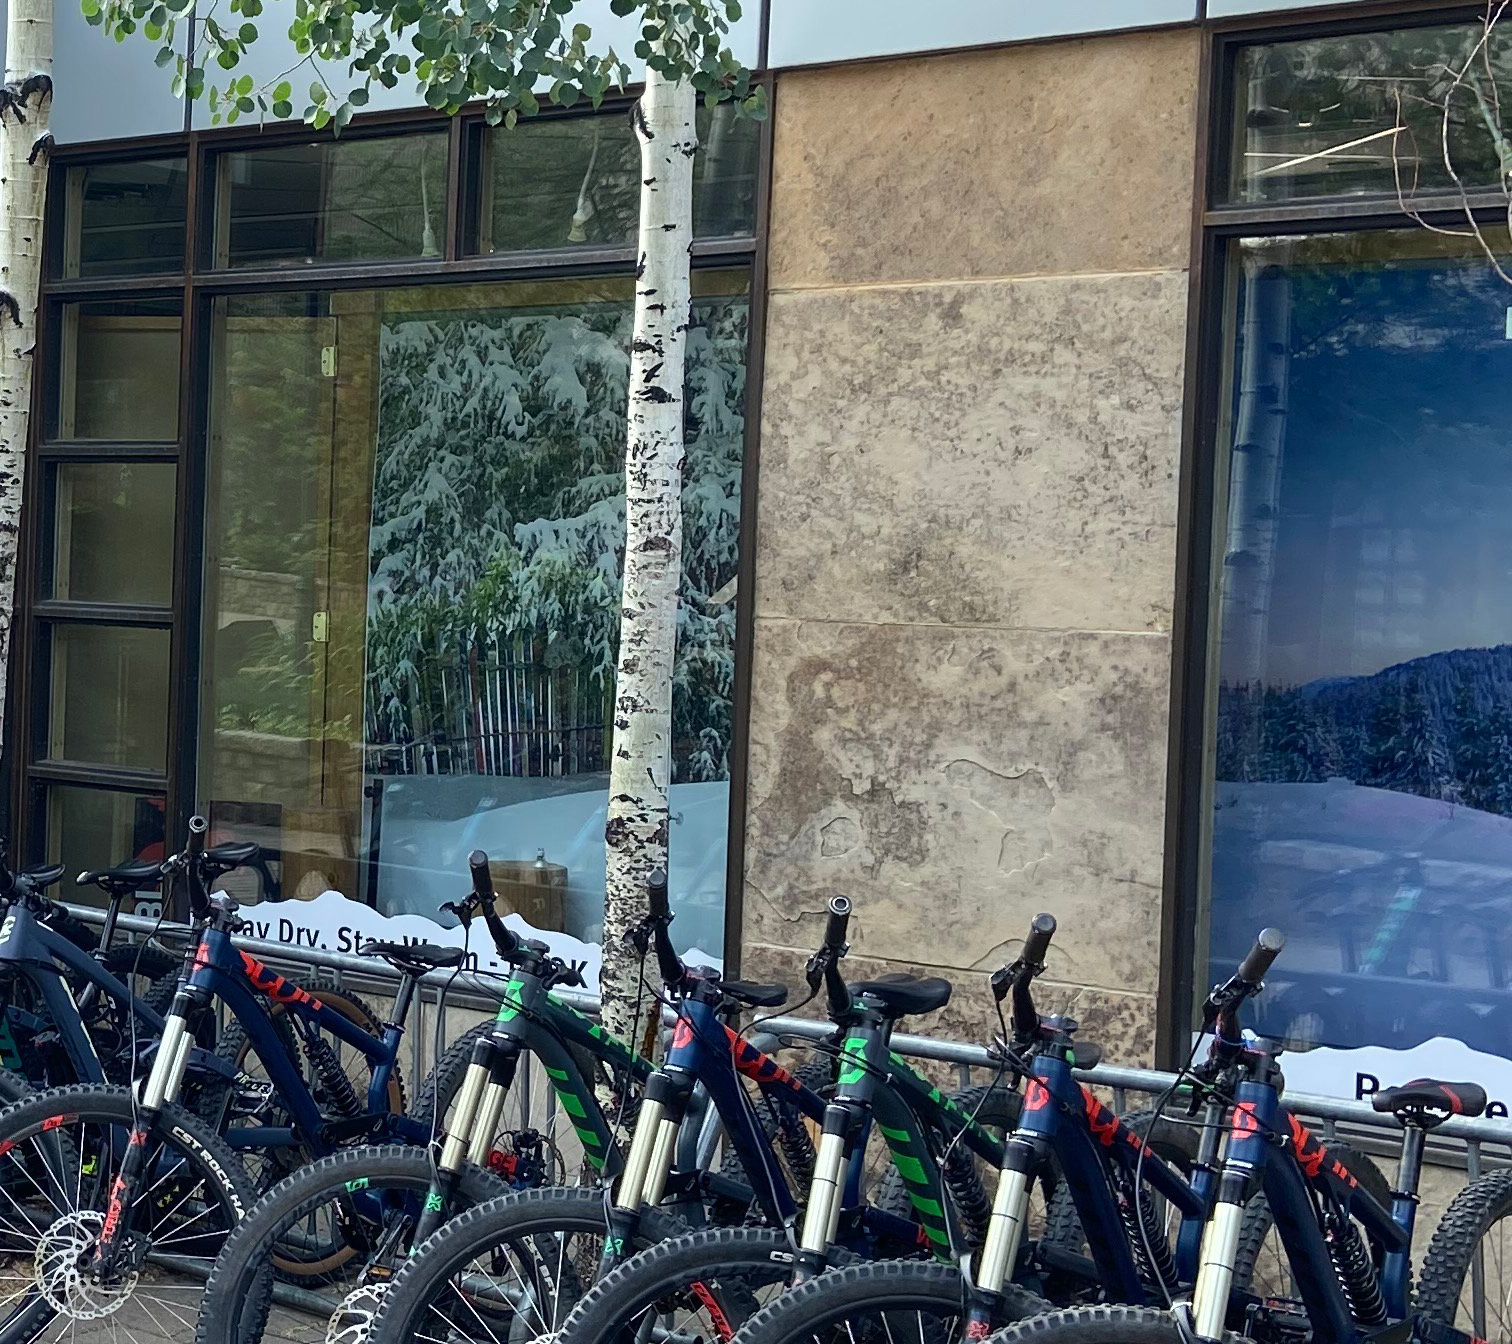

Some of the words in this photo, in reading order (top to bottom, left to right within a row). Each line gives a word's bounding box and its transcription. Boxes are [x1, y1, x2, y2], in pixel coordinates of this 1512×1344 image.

[172, 1126, 203, 1150] CST
[200, 1149, 235, 1192] ROCK
[230, 1194, 246, 1220] HA
[769, 1250, 794, 1263] CS
